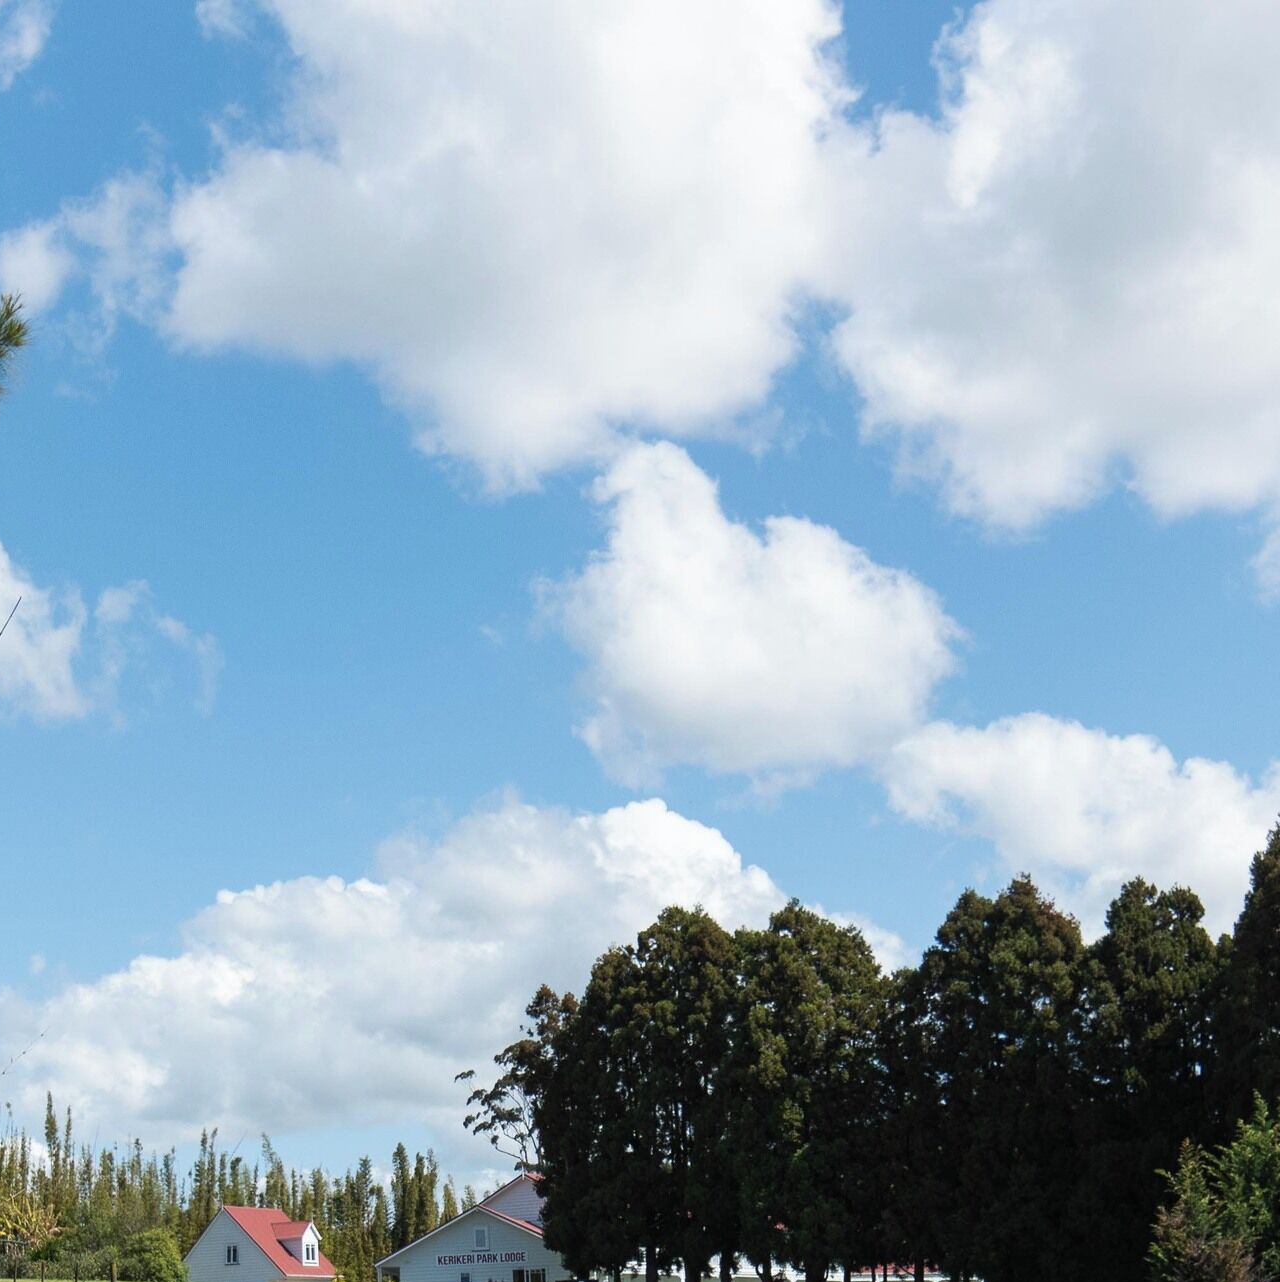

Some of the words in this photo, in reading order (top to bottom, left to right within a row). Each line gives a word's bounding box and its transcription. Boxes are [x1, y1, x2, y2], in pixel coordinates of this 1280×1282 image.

[438, 1254, 475, 1265] KERIKERI
[477, 1254, 498, 1264] PARK
[500, 1252, 526, 1263] LODGE
